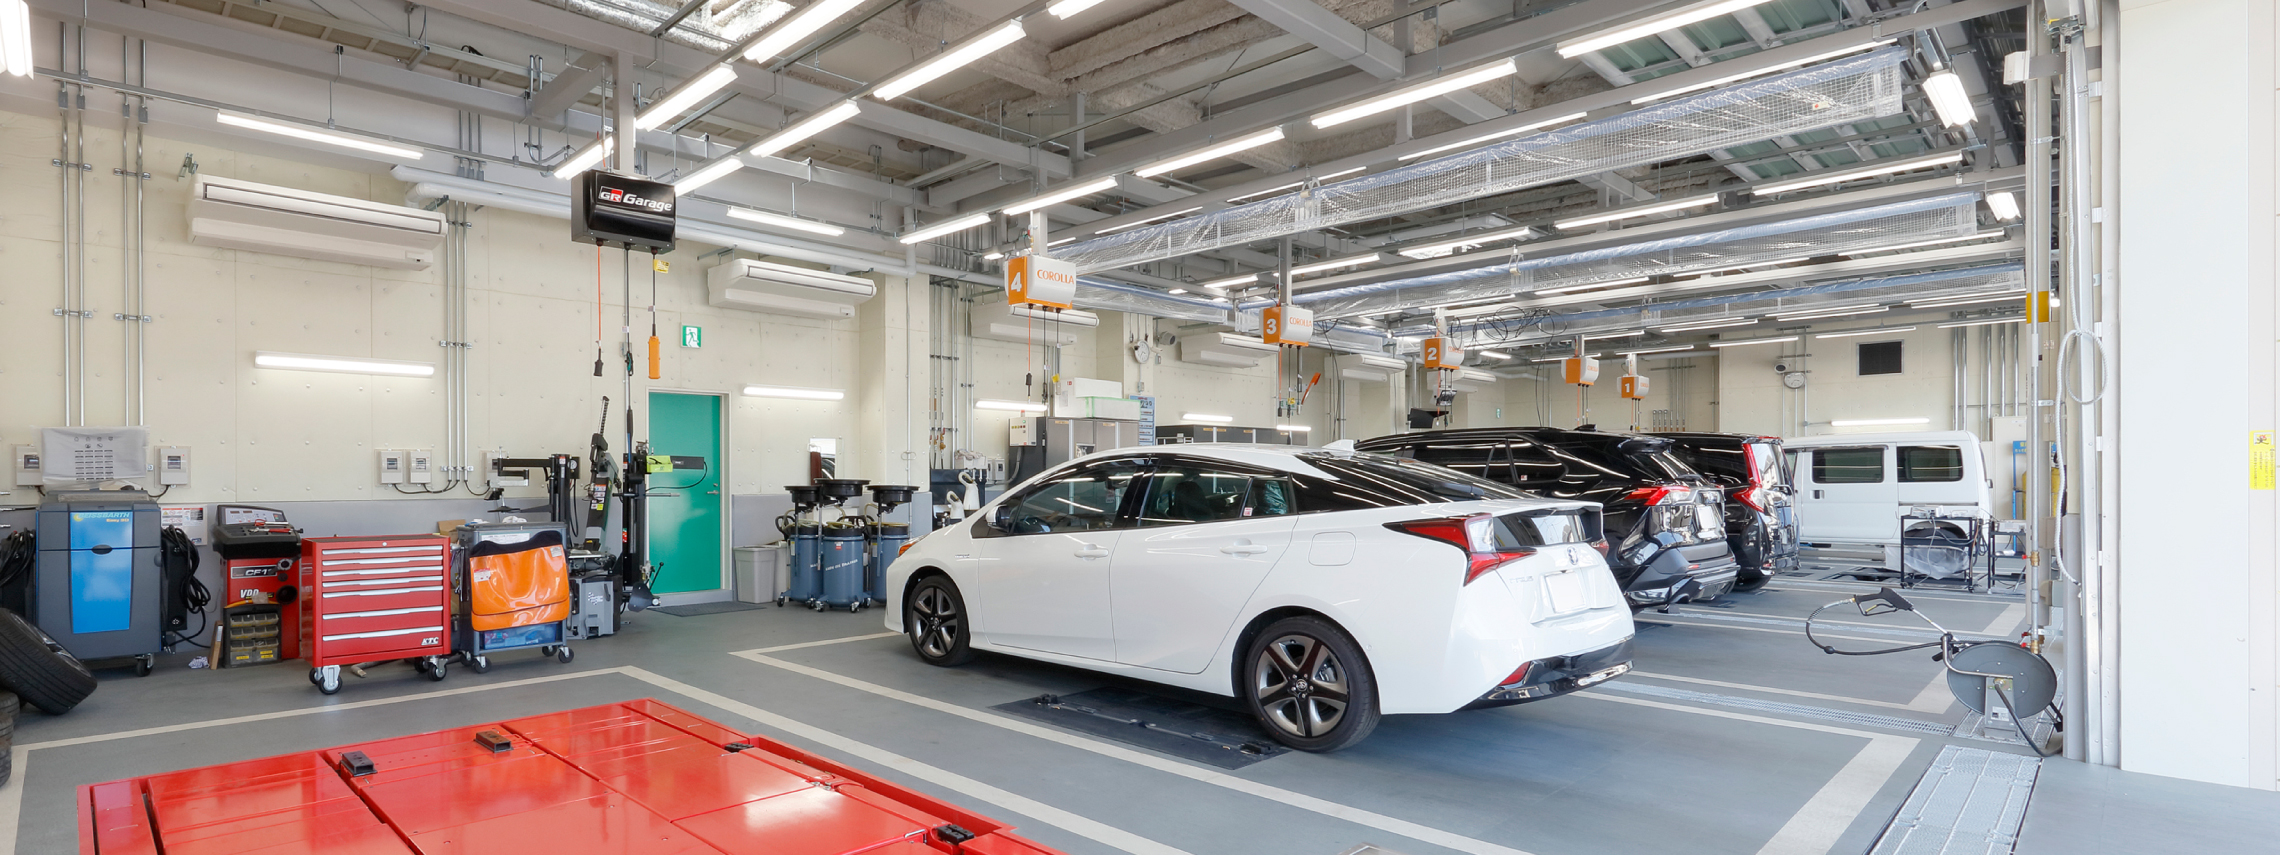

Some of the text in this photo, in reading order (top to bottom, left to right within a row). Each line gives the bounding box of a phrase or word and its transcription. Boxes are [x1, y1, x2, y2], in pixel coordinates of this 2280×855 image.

[600, 191, 672, 211] GR Garage
[1011, 271, 1022, 292] 4
[1036, 269, 1074, 284] COROLLA
[1266, 318, 1277, 335] 3
[1289, 317, 1312, 327] COROLLA
[1427, 347, 1437, 361] 2
[1624, 383, 1630, 393] 1
[245, 568, 273, 576] CF1
[421, 637, 439, 645] KTC
